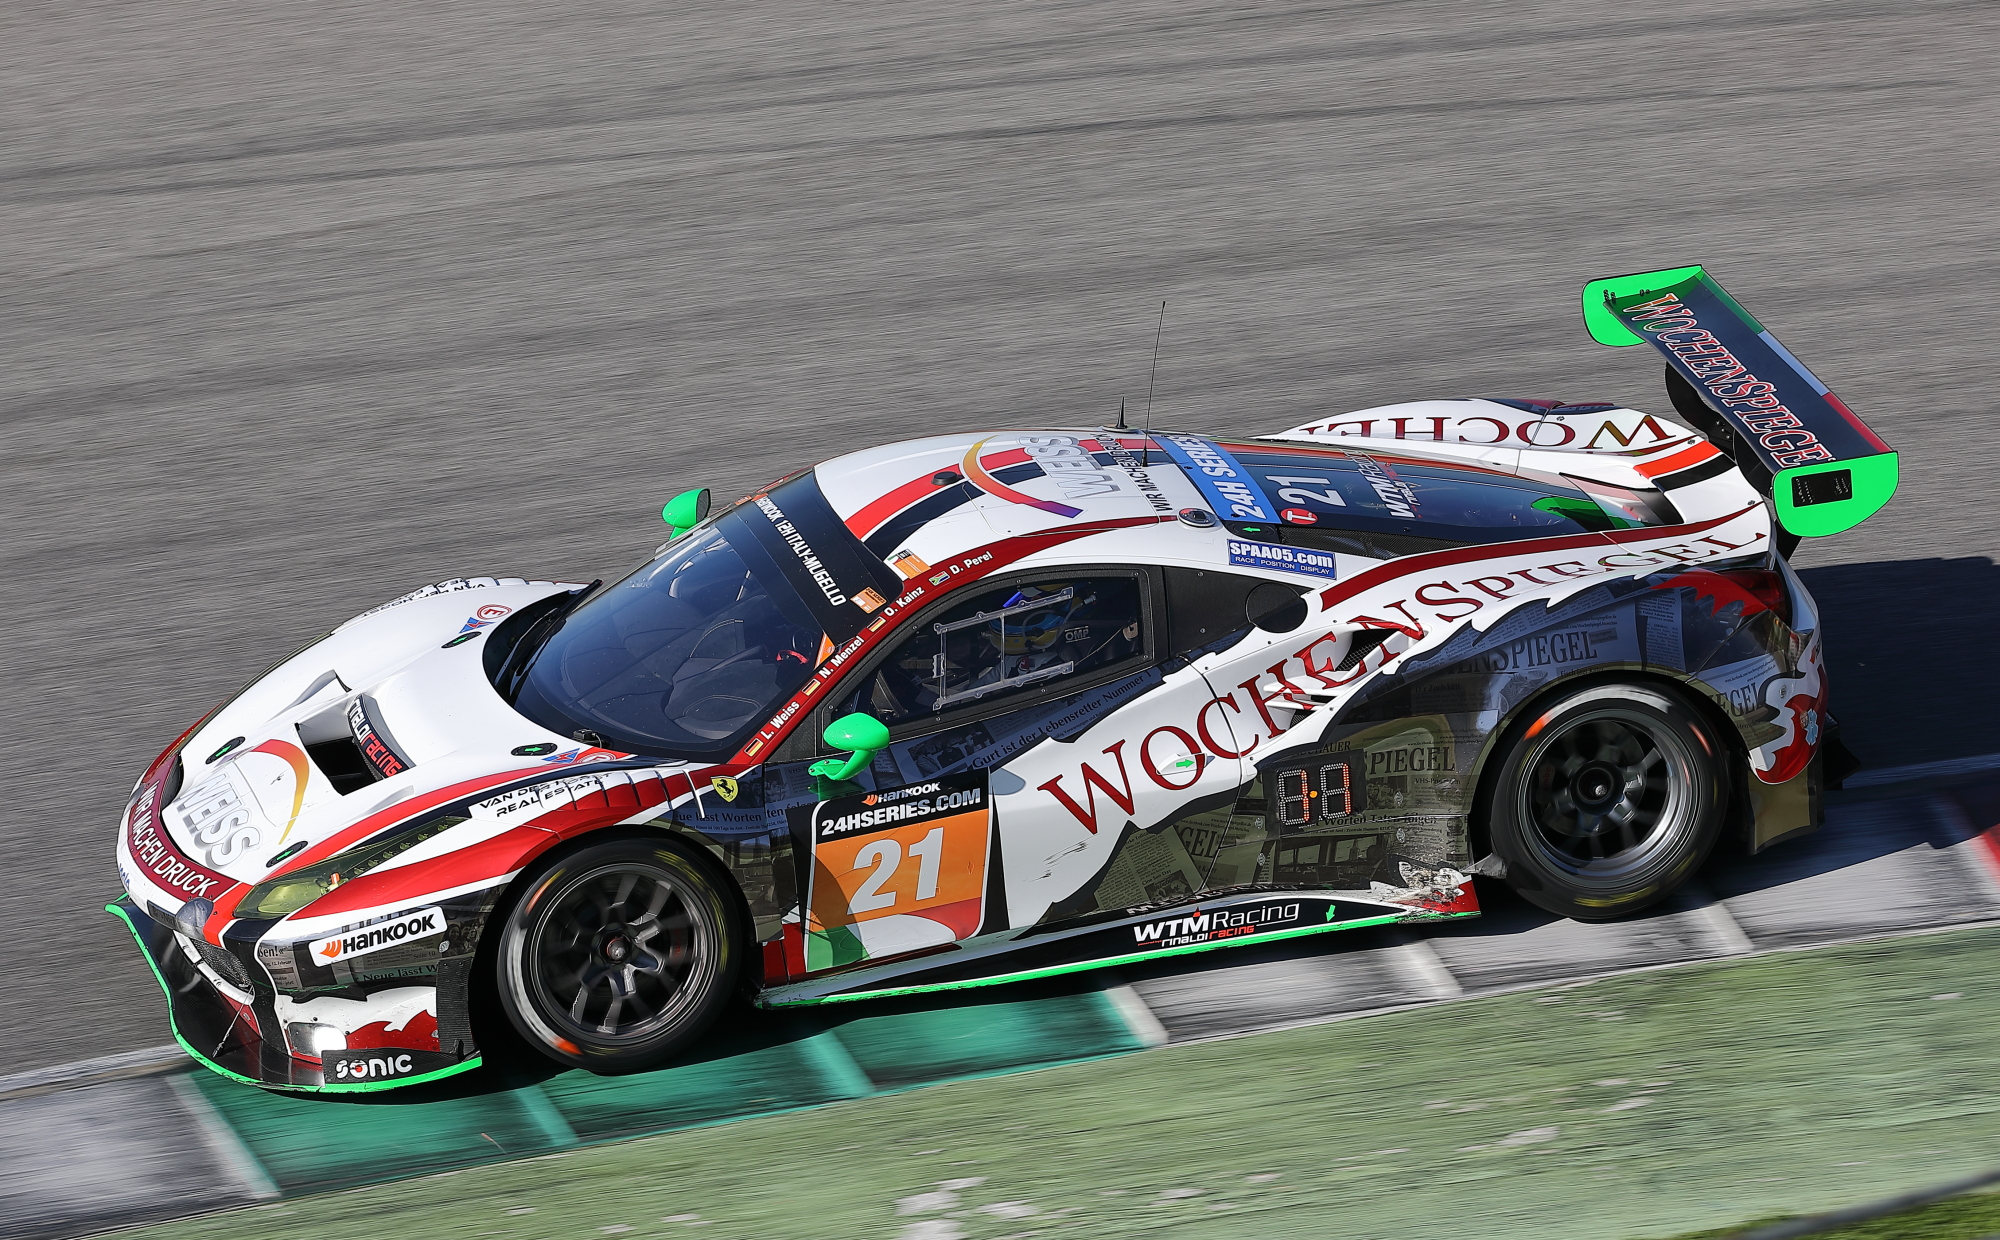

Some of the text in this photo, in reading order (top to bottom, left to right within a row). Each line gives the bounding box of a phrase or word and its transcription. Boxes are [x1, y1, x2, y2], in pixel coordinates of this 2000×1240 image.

[1622, 292, 1837, 469] WOCHENSPIEGE
[1017, 435, 1121, 500] WEISS
[1164, 434, 1268, 520] 24H SERIES
[1145, 493, 1174, 512] WIR
[1265, 475, 1347, 507] 21
[785, 532, 847, 607] ITALY-MUGELLO
[949, 550, 994, 576] D. Perel
[1235, 556, 1331, 576] RACE POSITION DISPLAY
[895, 585, 926, 608] Kainz
[1065, 629, 1090, 641] OMP
[818, 636, 866, 680] N. Menzel
[760, 700, 801, 740] L. Weiss
[972, 748, 1000, 770] Gurt
[1001, 740, 1017, 757] ist
[1017, 727, 1039, 750] der
[1037, 698, 1104, 736] Lebensretter
[1101, 675, 1145, 704] Nummer
[479, 792, 513, 809] VAN
[496, 778, 604, 818] REAL ESTATE
[721, 811, 762, 823] Worten
[821, 787, 982, 837] 24HSERIES.COM
[132, 779, 219, 897] WIR MACHEN DRUCK
[177, 772, 261, 868] WEISS
[846, 826, 945, 916] 21
[1133, 902, 1301, 943] WTM Racing
[362, 970, 396, 982] Neue
[397, 964, 425, 978] lässt
